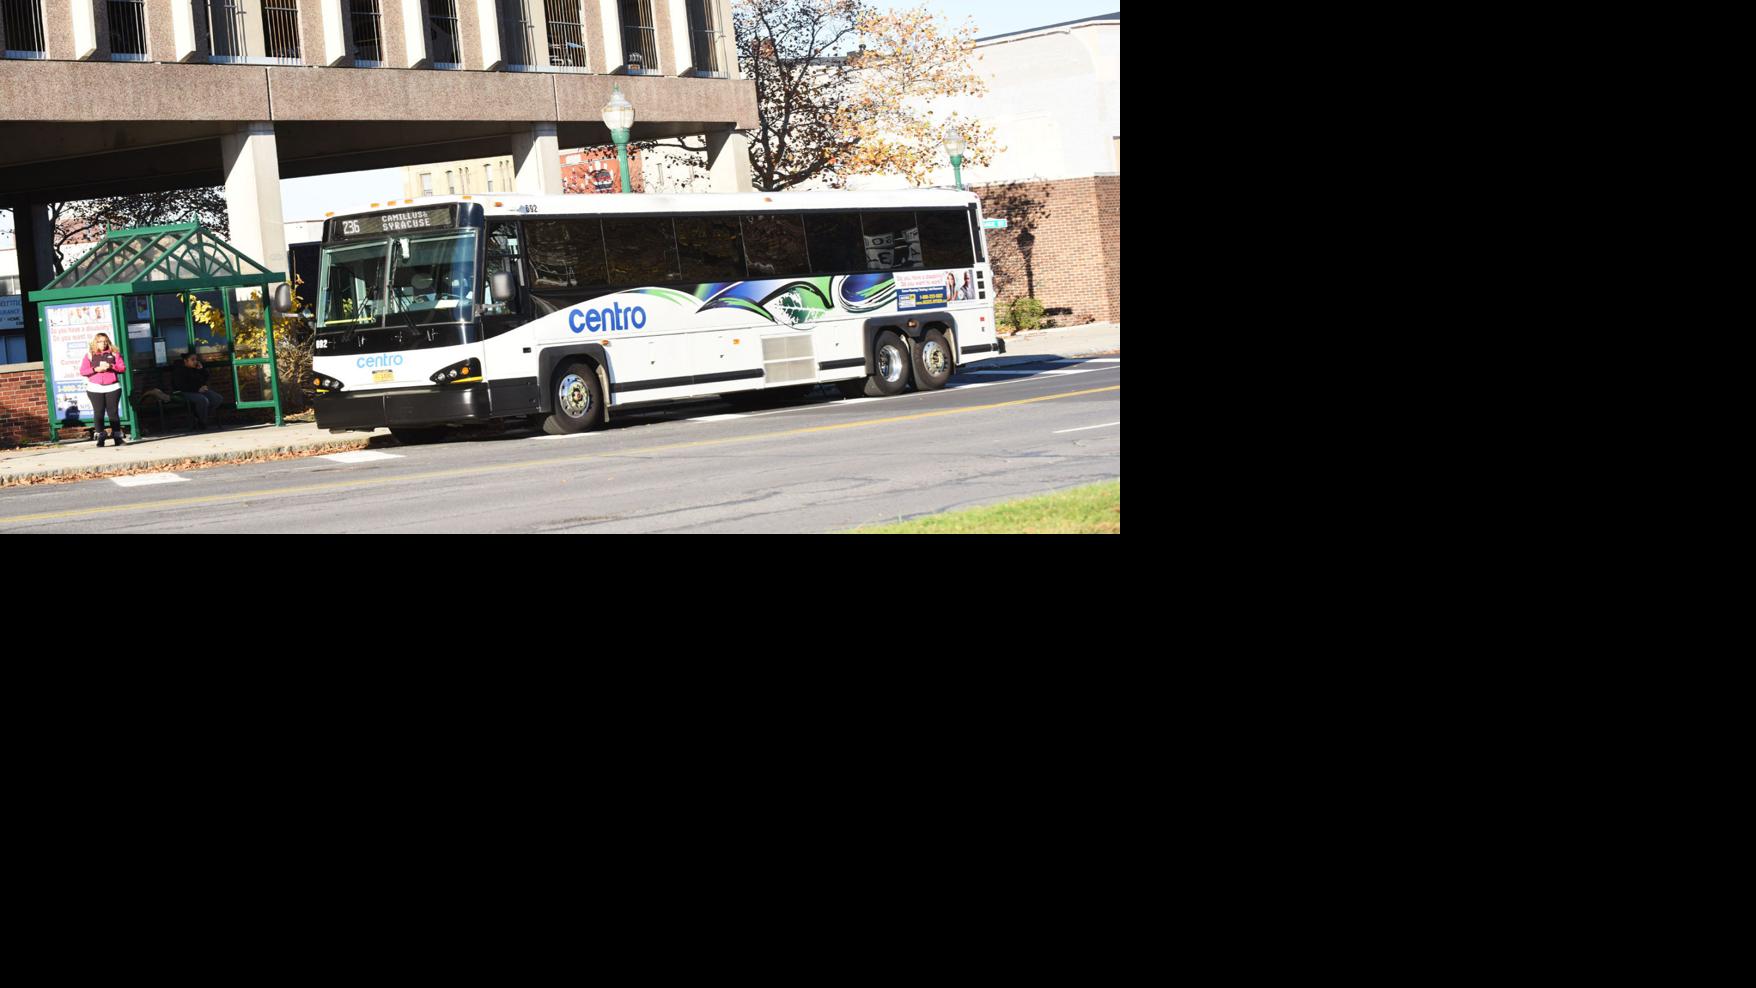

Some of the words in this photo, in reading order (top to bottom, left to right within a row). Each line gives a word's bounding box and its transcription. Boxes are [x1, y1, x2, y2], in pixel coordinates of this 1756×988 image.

[342, 219, 361, 235] 236
[382, 218, 431, 231] SYRACUSE
[568, 301, 647, 334] centro
[356, 353, 404, 369] centro
